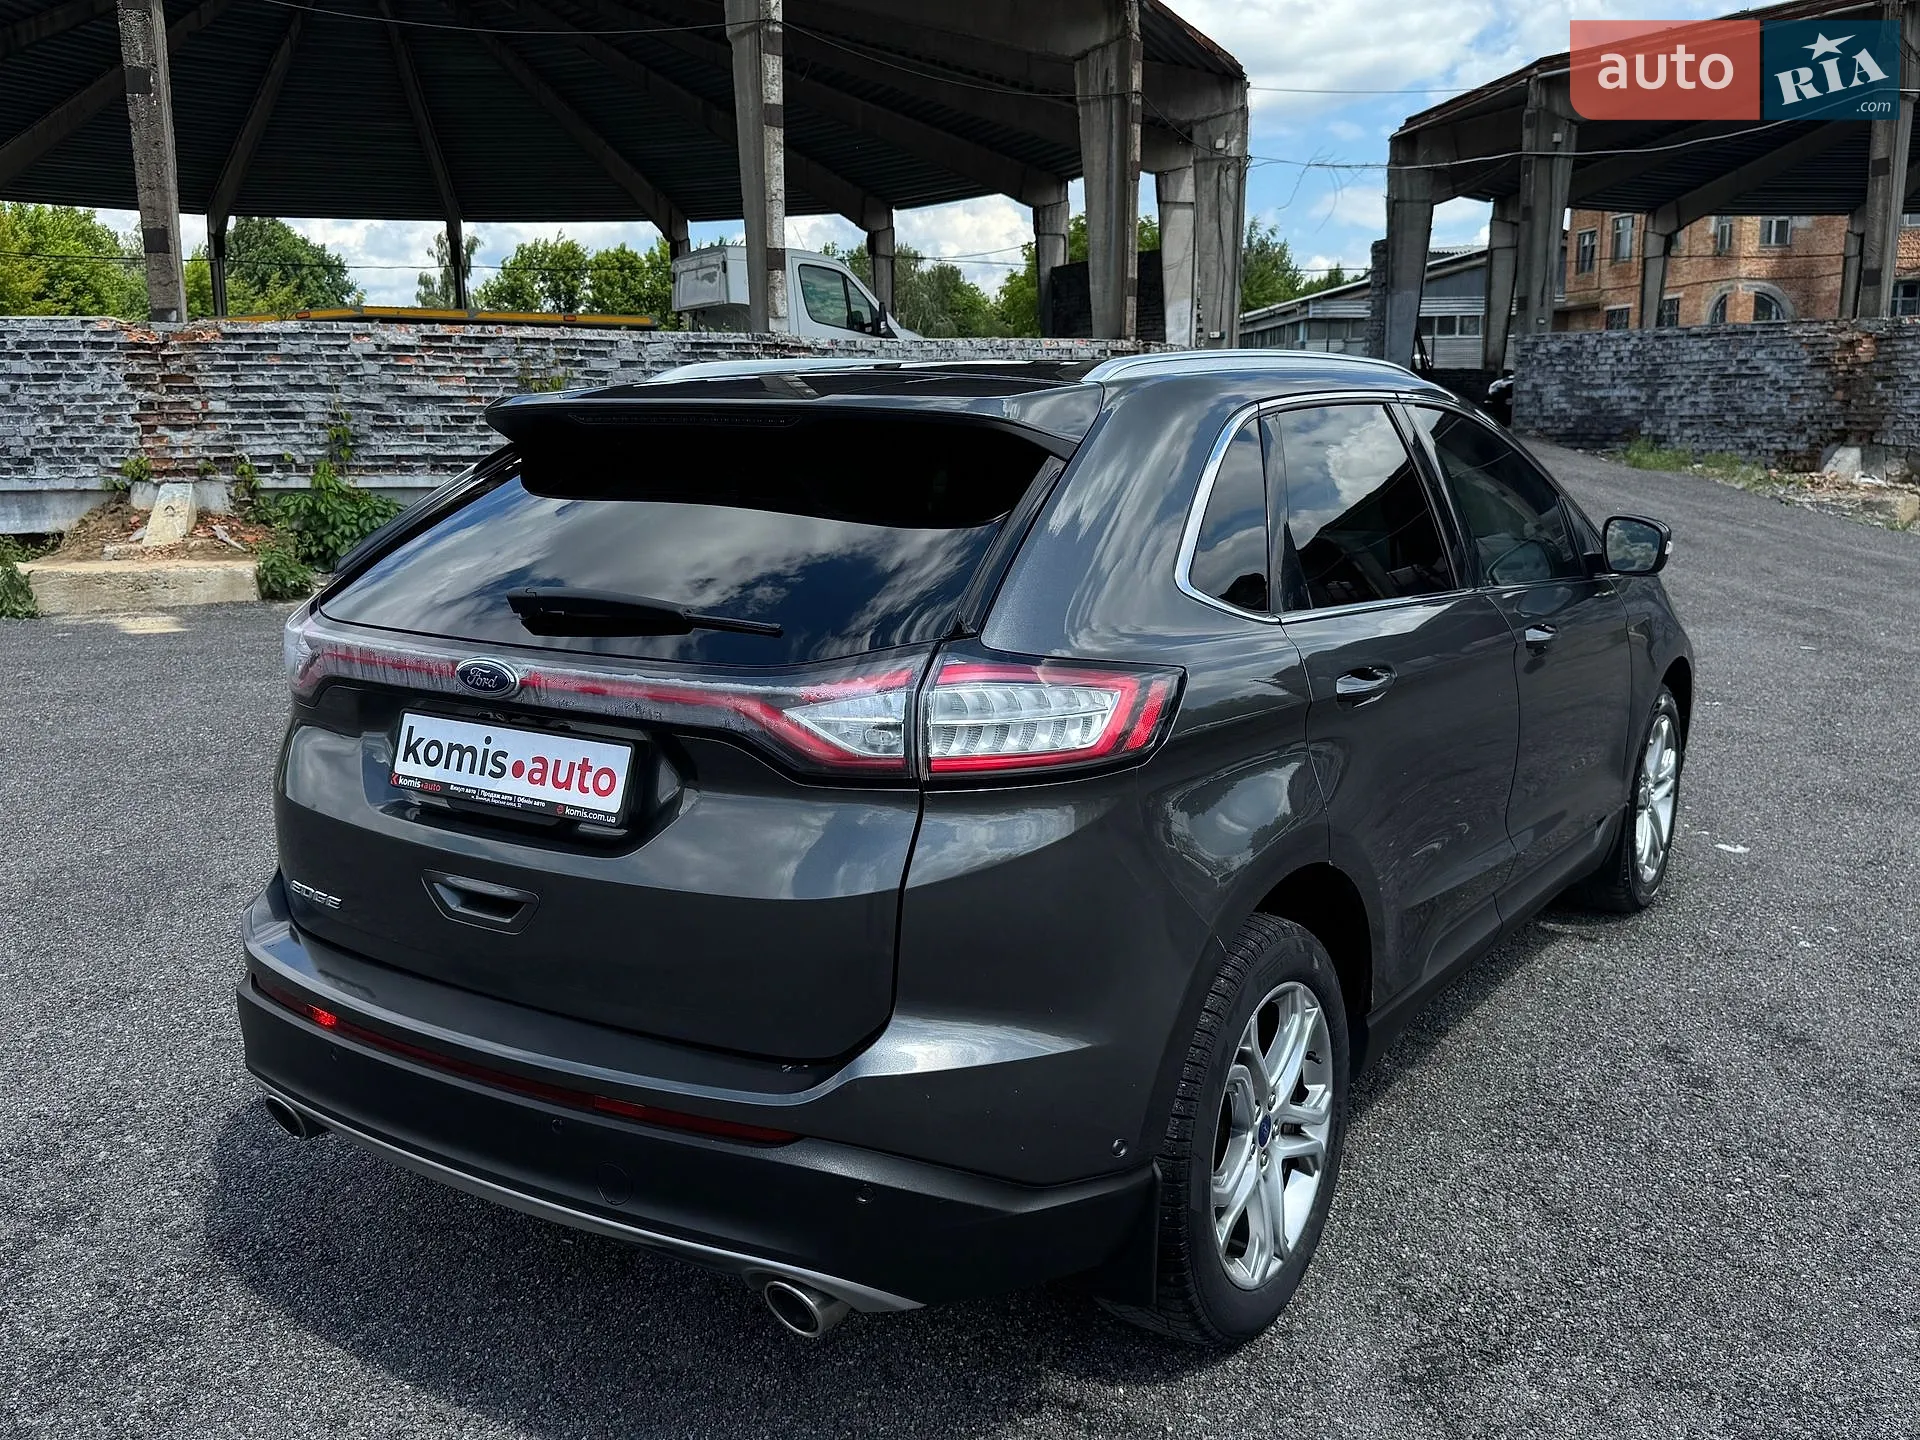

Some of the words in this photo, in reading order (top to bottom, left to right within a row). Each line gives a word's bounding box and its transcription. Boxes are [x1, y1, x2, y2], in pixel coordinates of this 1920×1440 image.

[466, 667, 498, 688] Ford
[565, 806, 616, 823] komis.com.ua
[290, 879, 342, 909] EDGE
